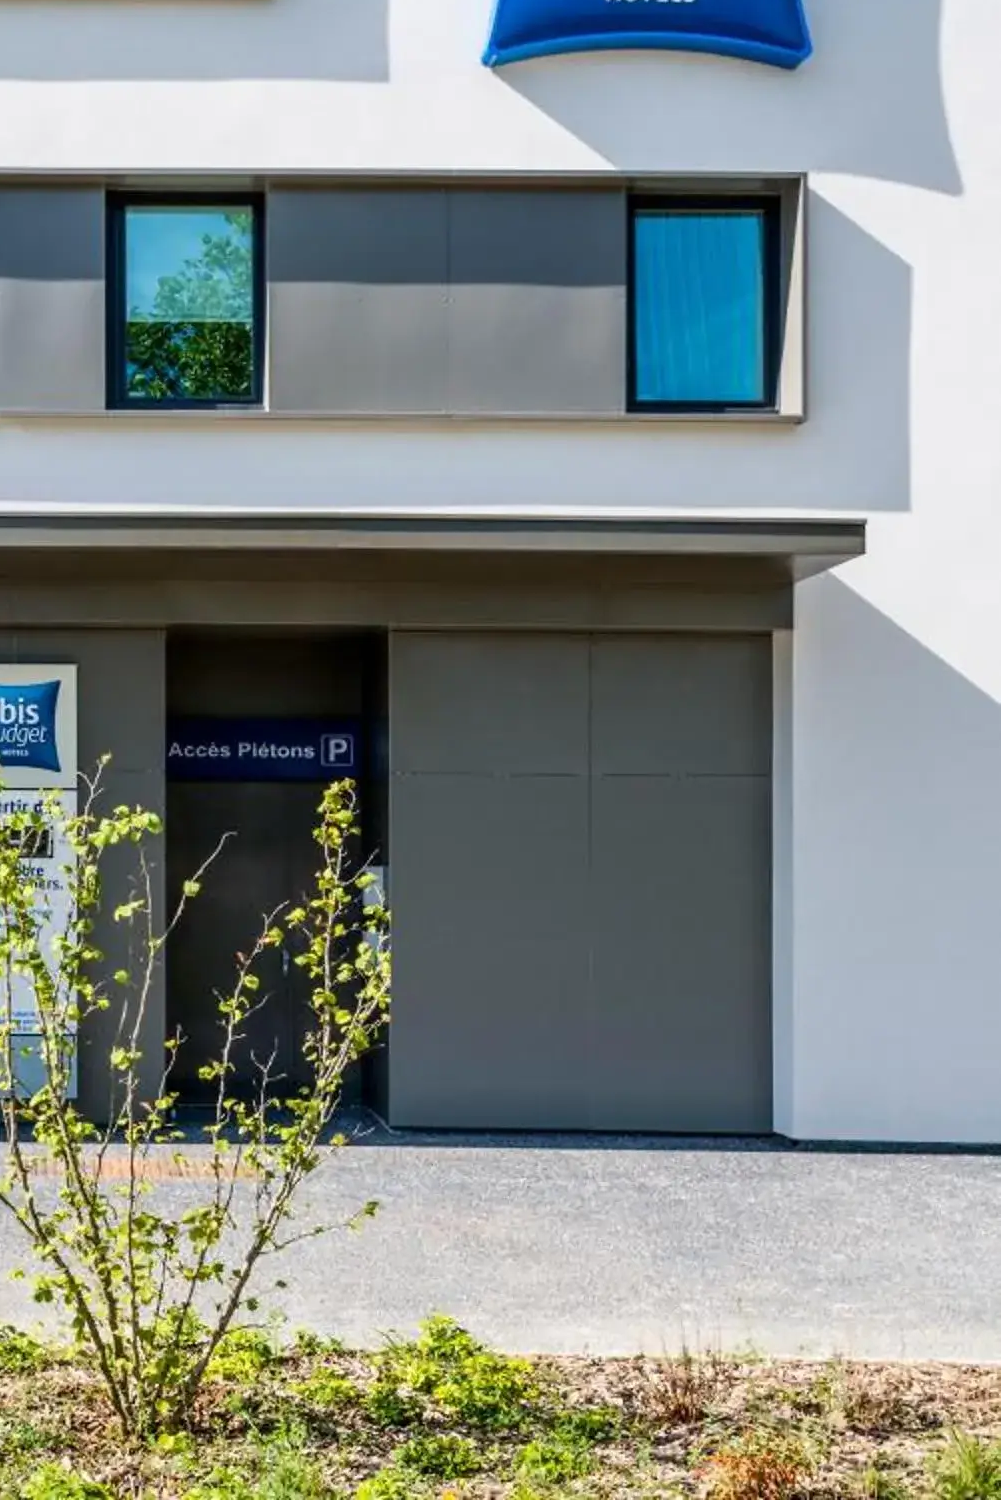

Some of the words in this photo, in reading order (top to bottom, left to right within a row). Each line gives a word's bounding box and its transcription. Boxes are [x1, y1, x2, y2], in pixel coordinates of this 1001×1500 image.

[168, 741, 231, 758] Accès
[238, 741, 315, 759] Piétons
[328, 738, 348, 762] P
